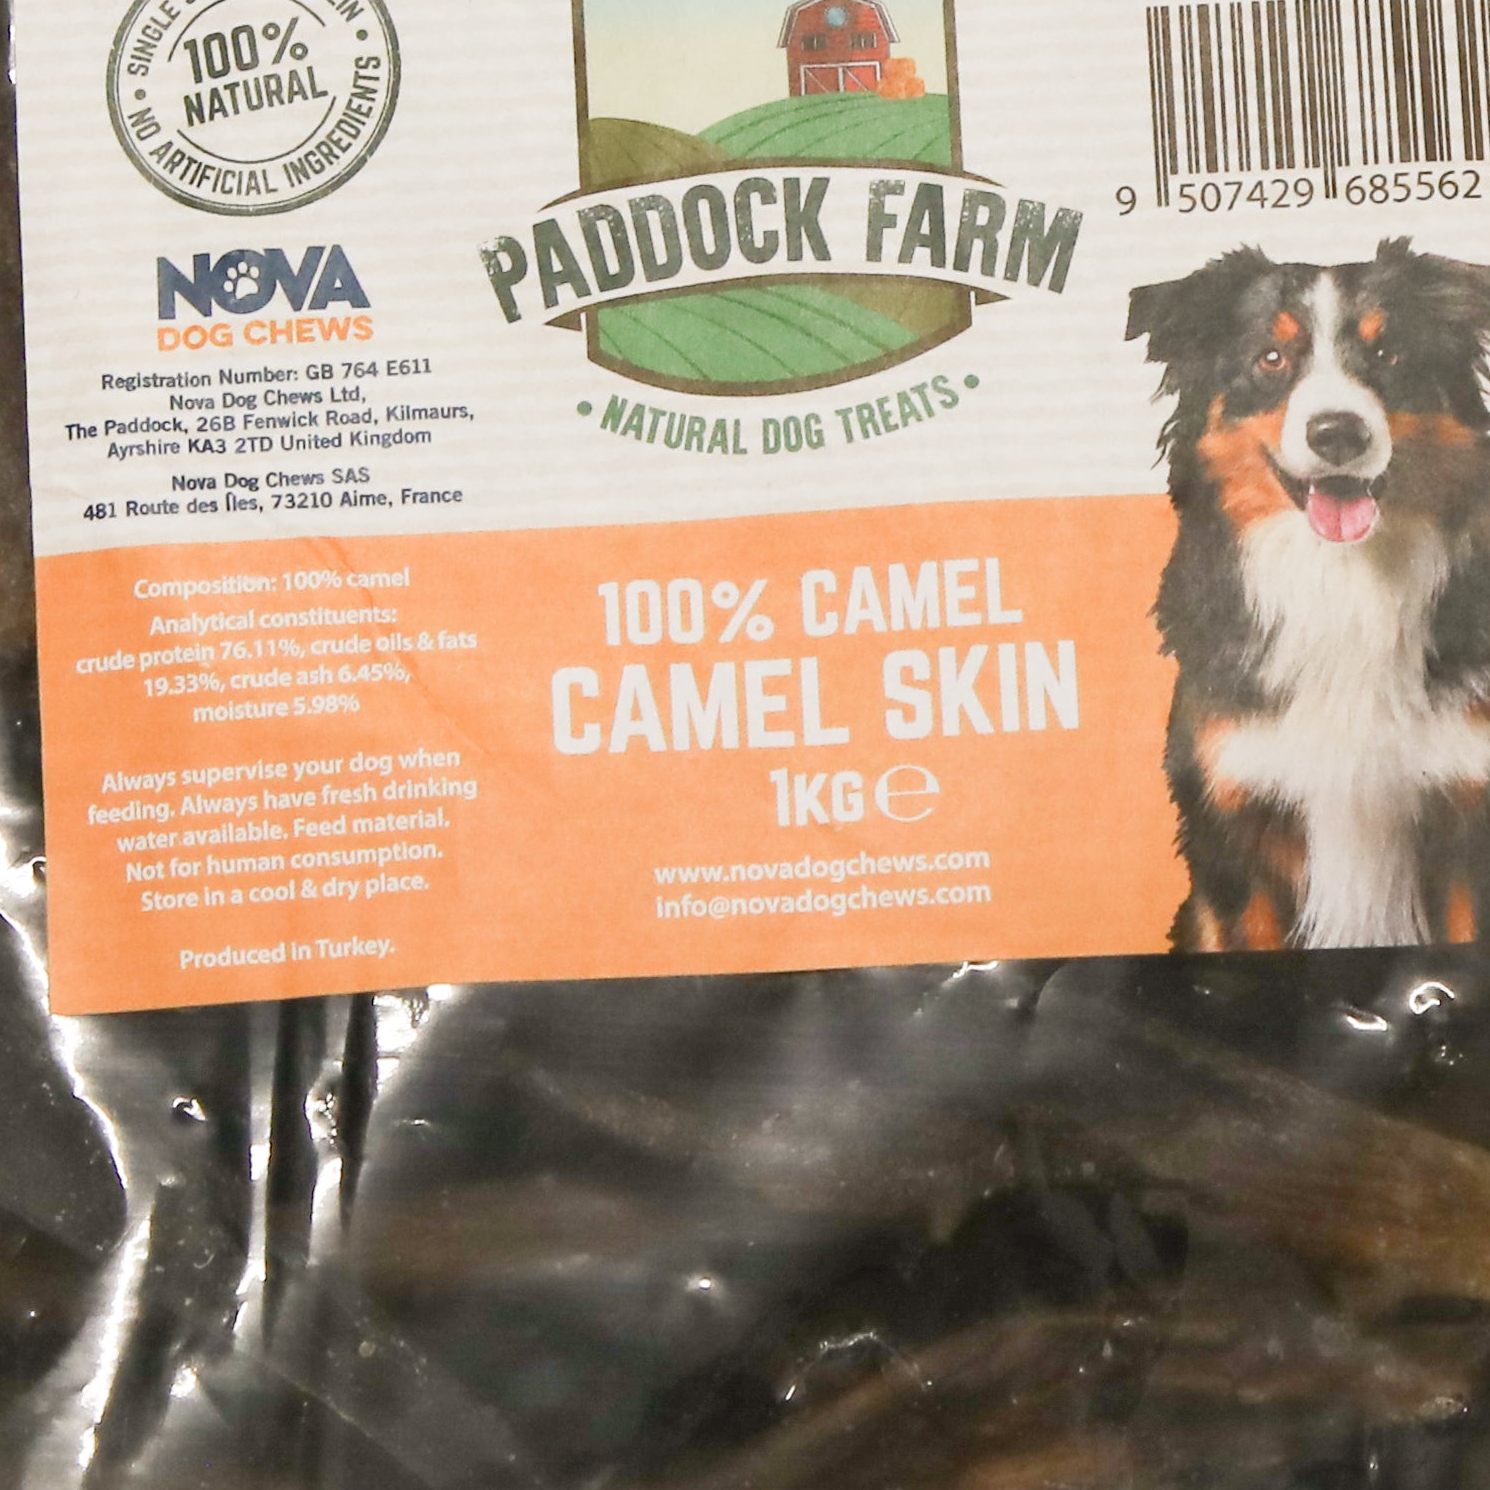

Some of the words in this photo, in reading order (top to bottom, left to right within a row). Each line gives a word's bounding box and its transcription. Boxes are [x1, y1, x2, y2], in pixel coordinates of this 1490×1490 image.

[127, 0, 181, 77] SINGLE
[183, 16, 308, 84] 100%
[183, 66, 329, 127] NATURAL
[127, 106, 162, 141] NO
[149, 140, 279, 196] ARTIFICIAL
[283, 56, 381, 188] INGREDIENTS
[1115, 186, 1136, 216] 9
[1179, 176, 1314, 213] 507429
[1345, 170, 1481, 206] 685562
[477, 175, 832, 324] PADDOCK
[865, 178, 1084, 295] FARM
[157, 244, 371, 320] NOVA
[157, 323, 233, 351] DOG
[243, 315, 373, 345] CHEWS
[101, 370, 211, 391] Registration
[219, 366, 298, 385] Number:
[306, 363, 334, 381] GB
[342, 361, 378, 378] 764
[387, 358, 432, 376] E611
[170, 393, 215, 410] Nova
[222, 391, 257, 410] Dog
[263, 388, 323, 406] Chews
[331, 386, 366, 404] Ltd,
[600, 394, 747, 455] NATURAL
[761, 413, 825, 455] DOG
[836, 374, 961, 444] TREATS
[65, 423, 97, 441] The
[104, 417, 189, 437] Paddock,
[197, 416, 235, 433] 26B
[243, 412, 318, 430] Fenwick
[326, 408, 378, 427] Road,
[386, 402, 475, 423] Kilmaurs,
[108, 439, 180, 461] Ayrshire
[188, 438, 226, 454] KA3
[234, 435, 273, 453] 2TD
[281, 433, 342, 450] United
[350, 428, 432, 450] Kingdom
[172, 474, 216, 492] Nova
[224, 472, 259, 492] Dog
[266, 469, 324, 488] Chews
[332, 468, 370, 484] SAS
[83, 503, 117, 521] 481
[126, 499, 179, 517] Route
[187, 497, 218, 514] des
[271, 493, 333, 510] 73210
[339, 490, 392, 509] Aime,
[401, 487, 463, 504] France
[133, 575, 277, 601] Composition:
[282, 571, 342, 591] 100%
[346, 567, 409, 589] camel
[598, 577, 775, 646] 100%
[800, 556, 1024, 638] CAMEL
[150, 609, 254, 636] Analytical
[259, 606, 397, 629] constituents:
[75, 653, 135, 675] crude
[139, 646, 214, 672] protein
[220, 639, 304, 660] 76.11%,
[310, 635, 371, 656] crude
[376, 632, 412, 652] oils
[416, 632, 433, 650] &
[438, 629, 478, 650] fats
[143, 675, 226, 697] 19.33%,
[230, 668, 290, 690] crude
[295, 666, 333, 686] ash
[338, 662, 410, 684] 6.45%,
[550, 656, 850, 756] CAMEL
[883, 639, 1080, 740] SKIN
[193, 699, 288, 723] moisture
[293, 694, 360, 716] 5.98%
[101, 771, 177, 794] Always
[181, 758, 288, 786] supervise
[293, 757, 344, 779] your
[349, 751, 393, 775] dog
[398, 747, 460, 769] when
[87, 801, 175, 825] feeding.
[179, 792, 257, 817] Always
[262, 789, 316, 810] have
[321, 784, 377, 806] fresh
[382, 776, 478, 800] drinking
[117, 831, 178, 852] water
[182, 820, 288, 846] available.
[293, 815, 347, 838] Feed
[352, 807, 450, 833] material.
[126, 862, 165, 882] Not
[169, 858, 202, 878] for
[207, 852, 285, 876] human
[290, 841, 443, 869] consumption.
[654, 849, 990, 885] www.novadogchews.com
[141, 887, 198, 912] Store
[204, 887, 225, 906] in
[230, 889, 244, 904] a
[248, 881, 296, 902] cool
[302, 879, 318, 898] &
[322, 876, 360, 900] dry
[365, 871, 429, 896] place.
[656, 882, 992, 919] info@novadogchews.com
[179, 940, 286, 969] Produced
[292, 938, 312, 959] in
[316, 935, 395, 961] Turkey.
